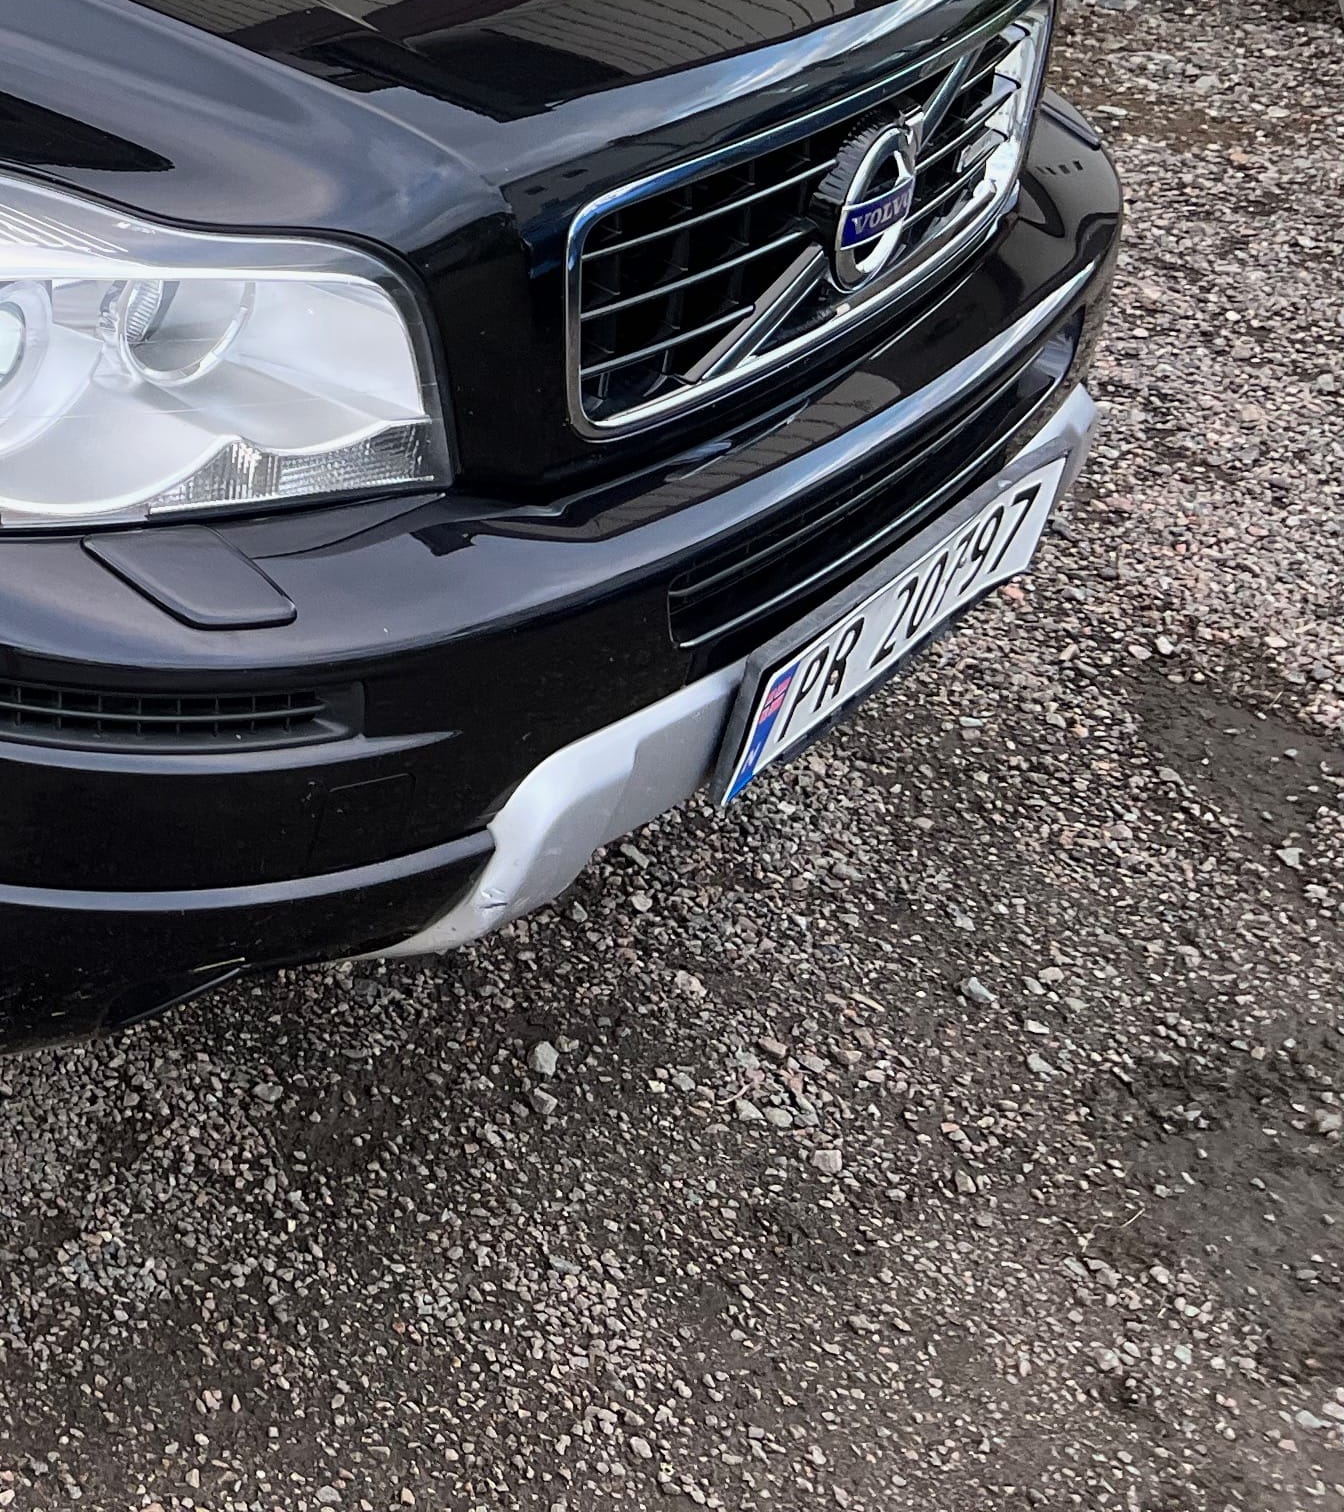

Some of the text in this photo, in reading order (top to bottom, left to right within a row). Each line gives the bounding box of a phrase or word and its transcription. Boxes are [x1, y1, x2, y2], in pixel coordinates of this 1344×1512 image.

[851, 192, 910, 235] VOLVO
[778, 482, 1043, 743] PR 20797
